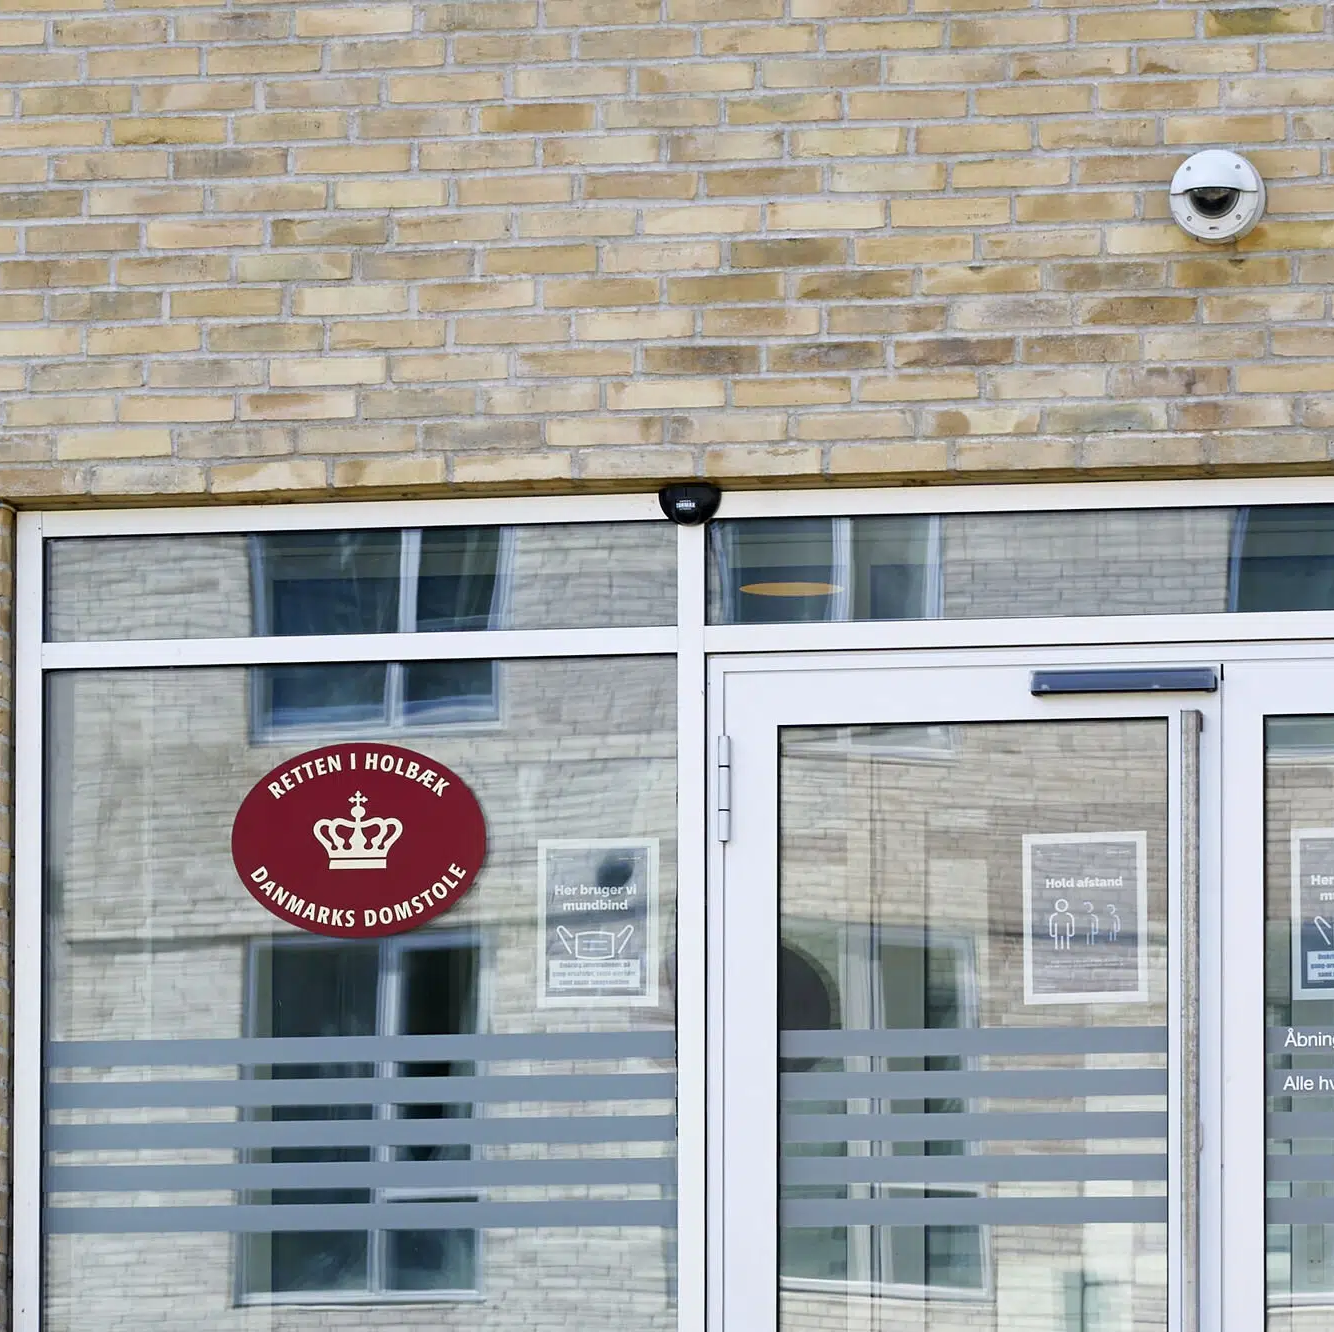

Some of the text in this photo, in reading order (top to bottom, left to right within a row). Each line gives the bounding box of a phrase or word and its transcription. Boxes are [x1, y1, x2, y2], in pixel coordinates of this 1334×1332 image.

[267, 752, 451, 799] RETTEN I HOLBÆK
[1045, 876, 1123, 888] Hold afstand
[1310, 874, 1334, 885] Her
[250, 862, 467, 928] DANMARKS DOMSTOLE
[554, 884, 637, 897] Her bruger vi
[563, 900, 628, 911] mundbind
[1283, 1076, 1314, 1091] Alle
